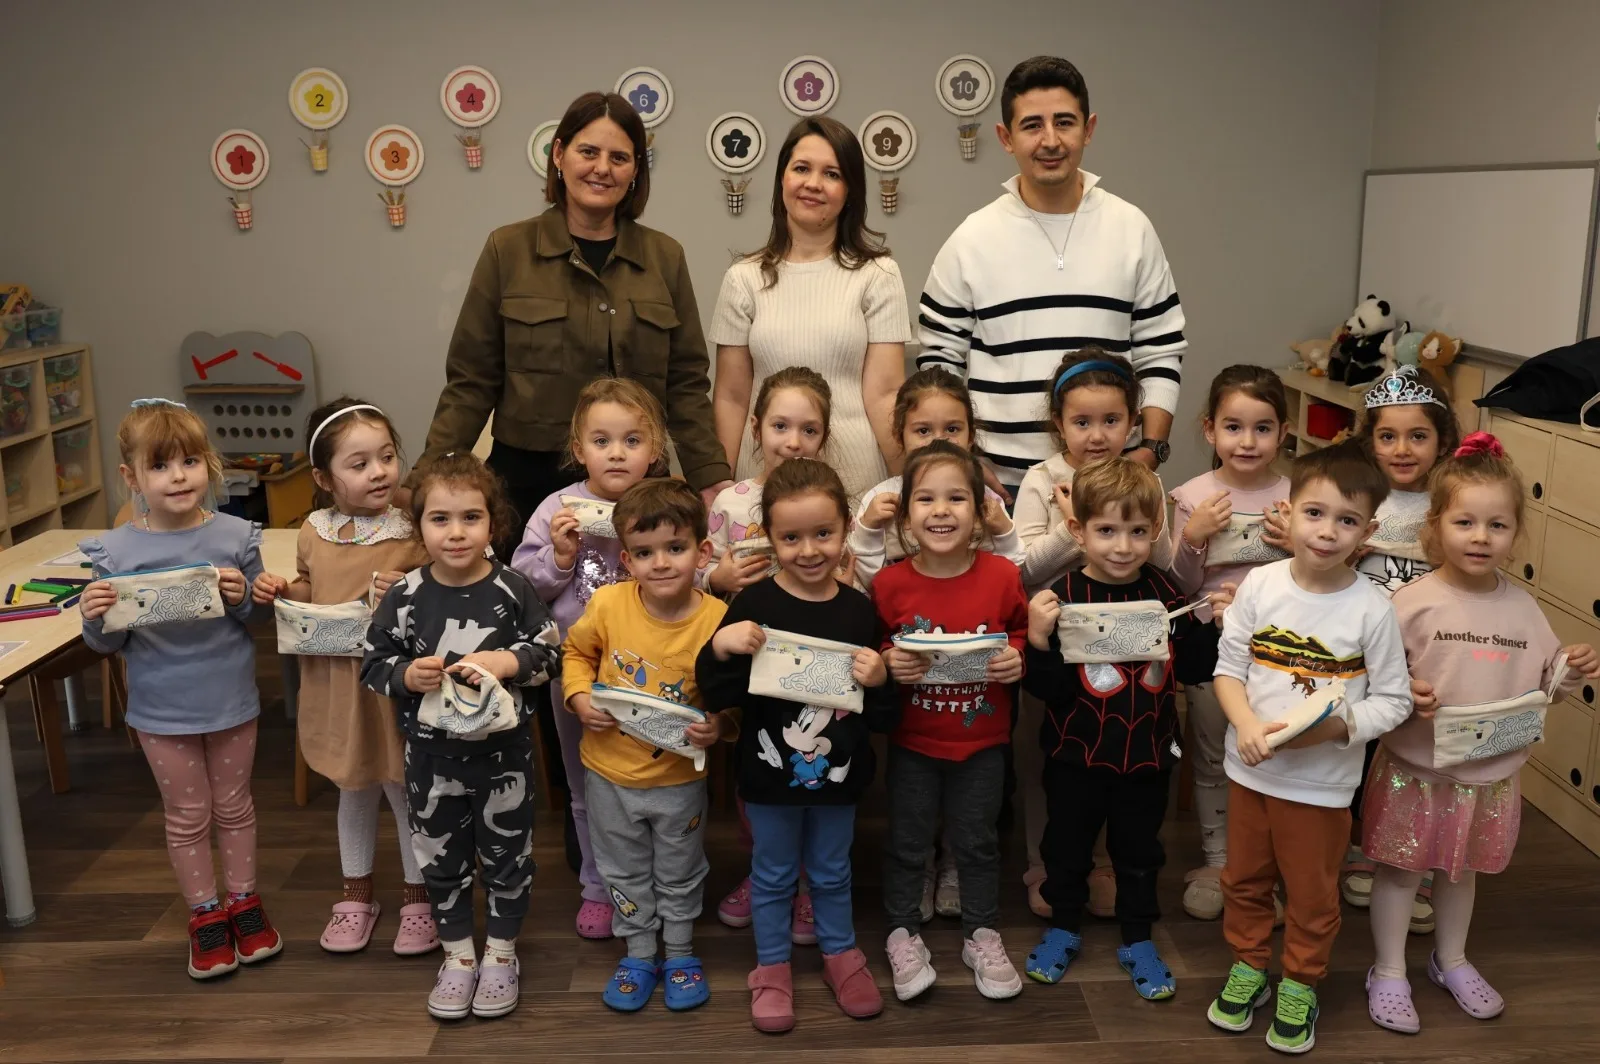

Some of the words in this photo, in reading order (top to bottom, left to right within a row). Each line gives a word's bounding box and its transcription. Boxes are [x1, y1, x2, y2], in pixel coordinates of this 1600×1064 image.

[804, 81, 815, 95] 8
[956, 80, 974, 95] 10
[314, 93, 325, 107] 2
[466, 93, 476, 106] 4
[639, 93, 650, 107] 6
[731, 138, 741, 152] 7
[882, 137, 892, 151] 9
[236, 153, 245, 168] 1
[391, 150, 400, 164] 3
[1433, 629, 1490, 644] Another
[1491, 633, 1529, 650] Sunset
[912, 693, 984, 712] BETTER
